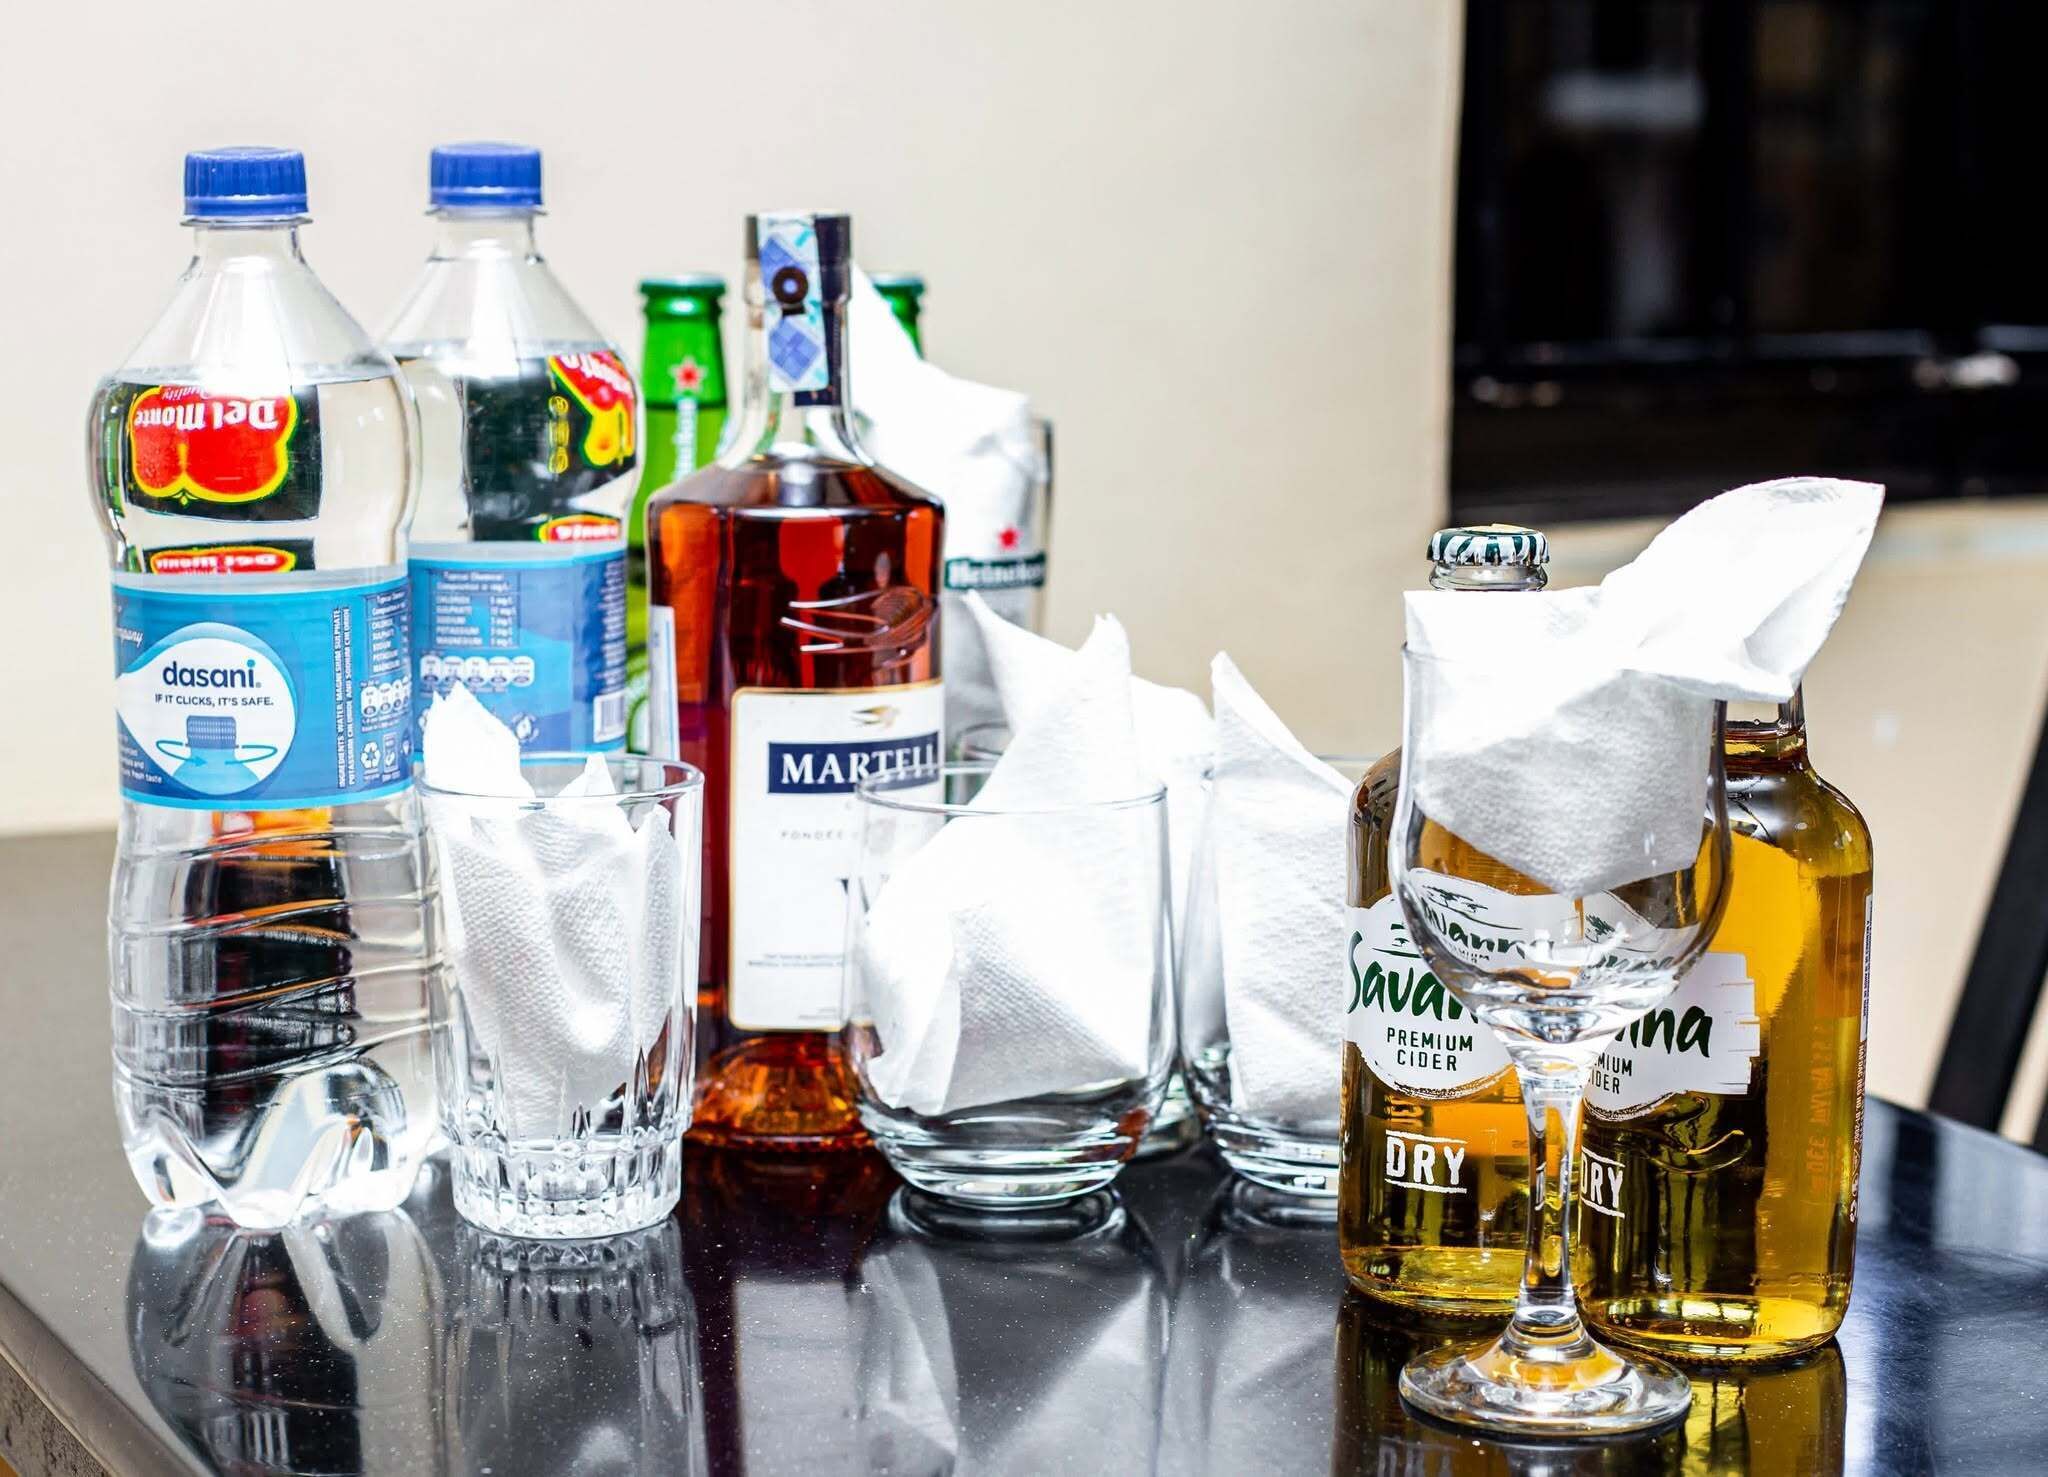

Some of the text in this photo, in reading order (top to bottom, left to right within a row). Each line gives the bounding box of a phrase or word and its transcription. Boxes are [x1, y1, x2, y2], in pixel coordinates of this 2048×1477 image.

[134, 399, 279, 431] Del Monte
[163, 659, 256, 688] dasani
[155, 693, 274, 707] IF IT CLICKS, IT'S SAFE.
[1347, 930, 1479, 1025] Sava
[1387, 1026, 1474, 1053] PREMIUM
[1397, 1048, 1458, 1072] CIDER
[1594, 1052, 1632, 1077] MIUM
[1588, 1068, 1620, 1094] IDER
[1386, 1136, 1465, 1186] DRY
